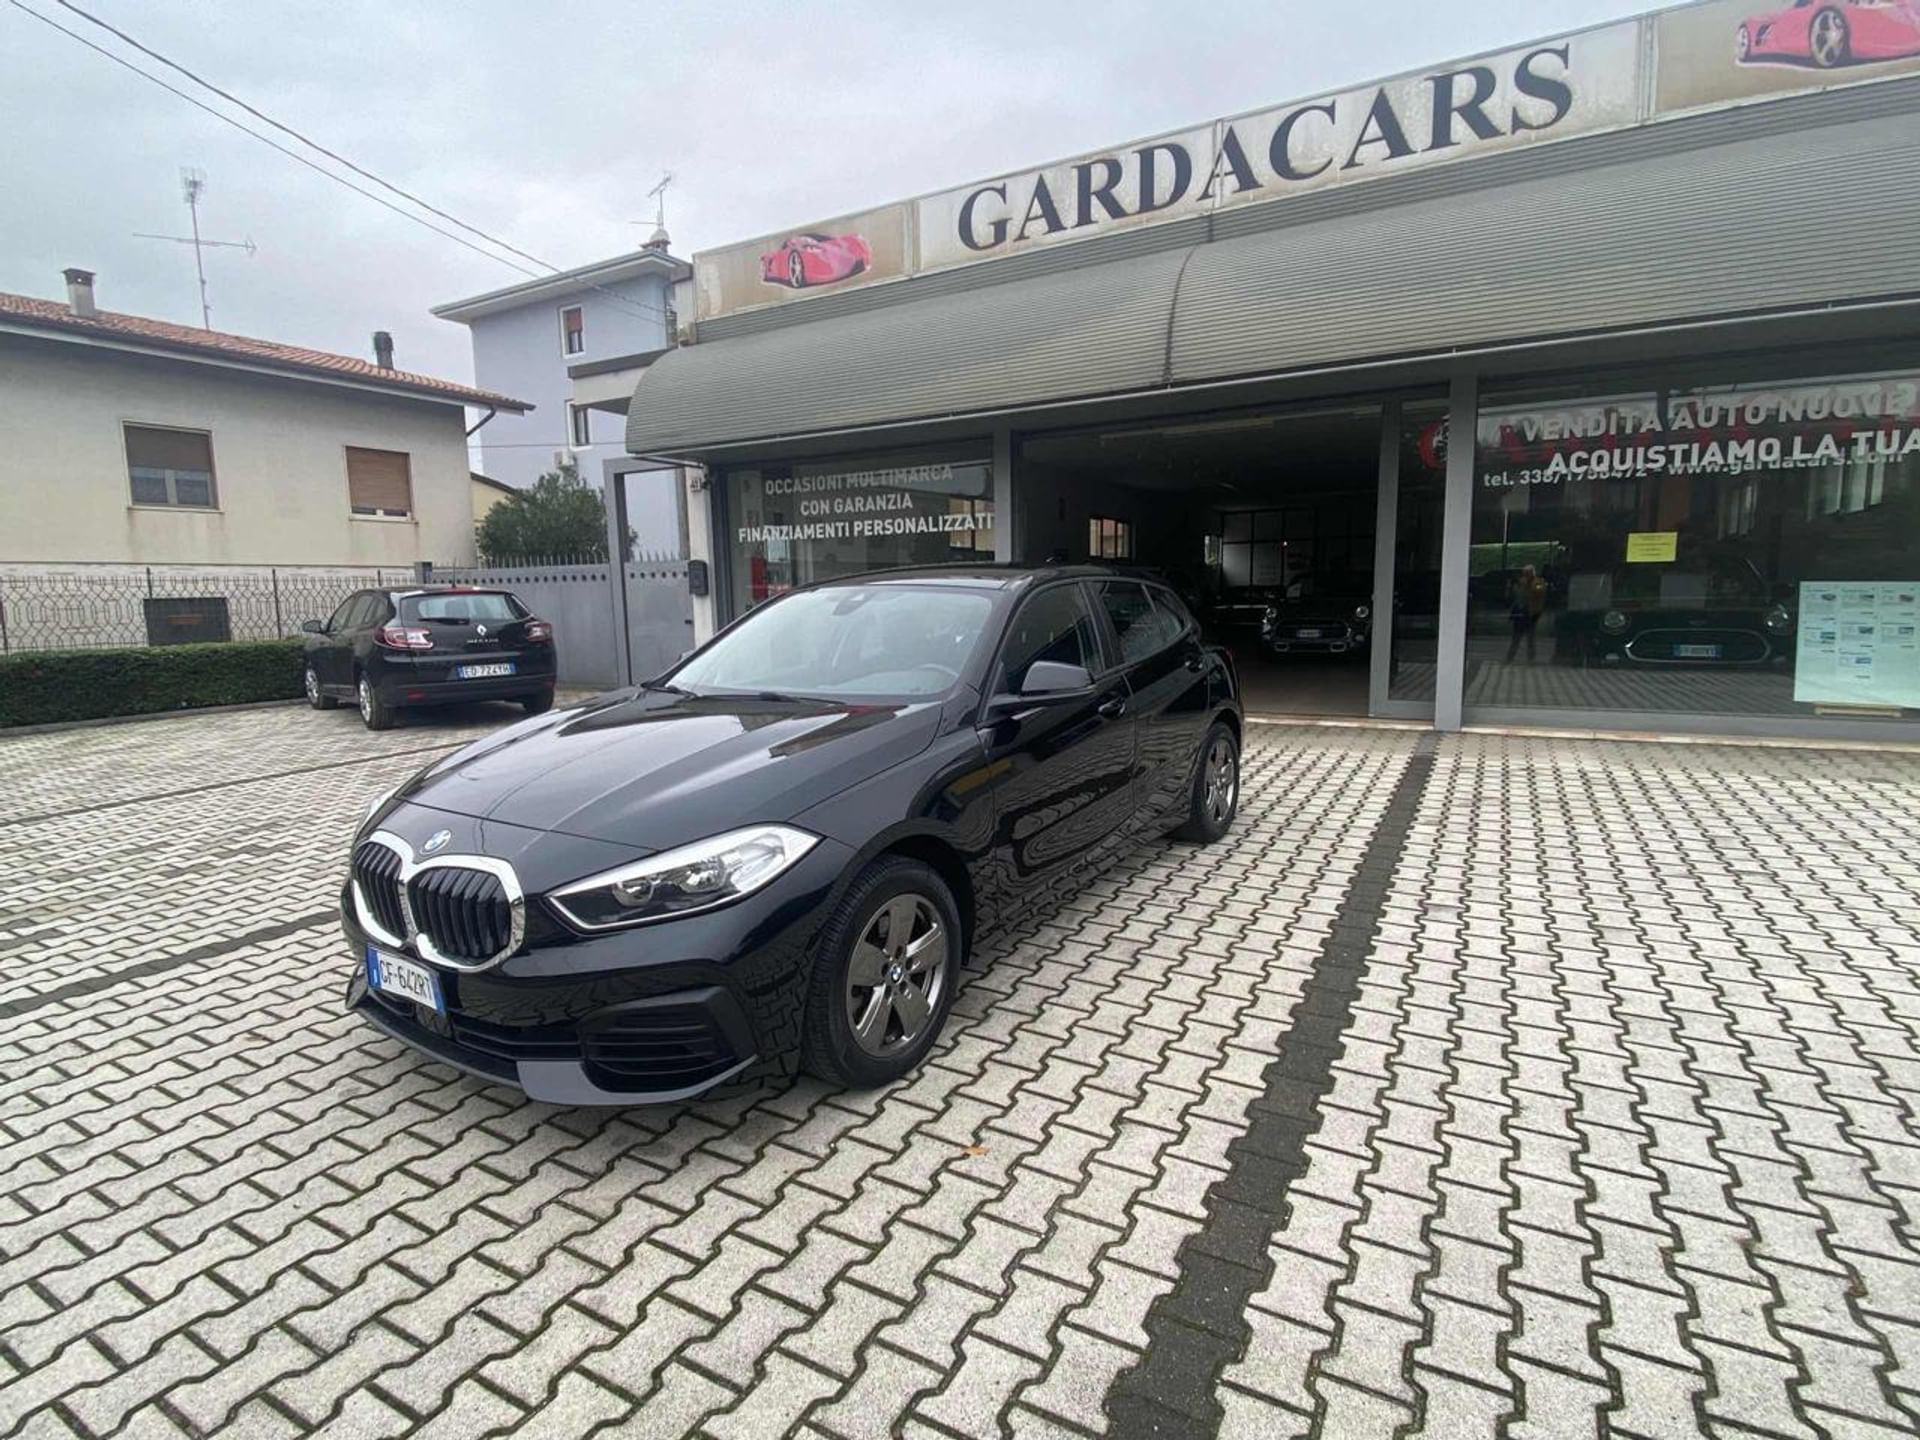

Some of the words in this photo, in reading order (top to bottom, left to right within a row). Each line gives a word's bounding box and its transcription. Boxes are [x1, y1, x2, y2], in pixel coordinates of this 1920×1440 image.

[957, 42, 1572, 251] GARDACARS
[1522, 407, 1662, 442] VENDITA
[1671, 401, 1768, 431] AUTO
[1549, 437, 1782, 475] ACQUISTIAMO
[1792, 432, 1841, 460] LA
[765, 473, 844, 495] OCCASIONI
[846, 464, 953, 488] MULTIMARCA
[1483, 470, 1515, 487] tel.
[800, 499, 830, 516] CON
[834, 493, 913, 514] GARANZIA
[738, 521, 850, 543] FINANZIAMENTI
[853, 512, 994, 537] PERSONALIZZATI
